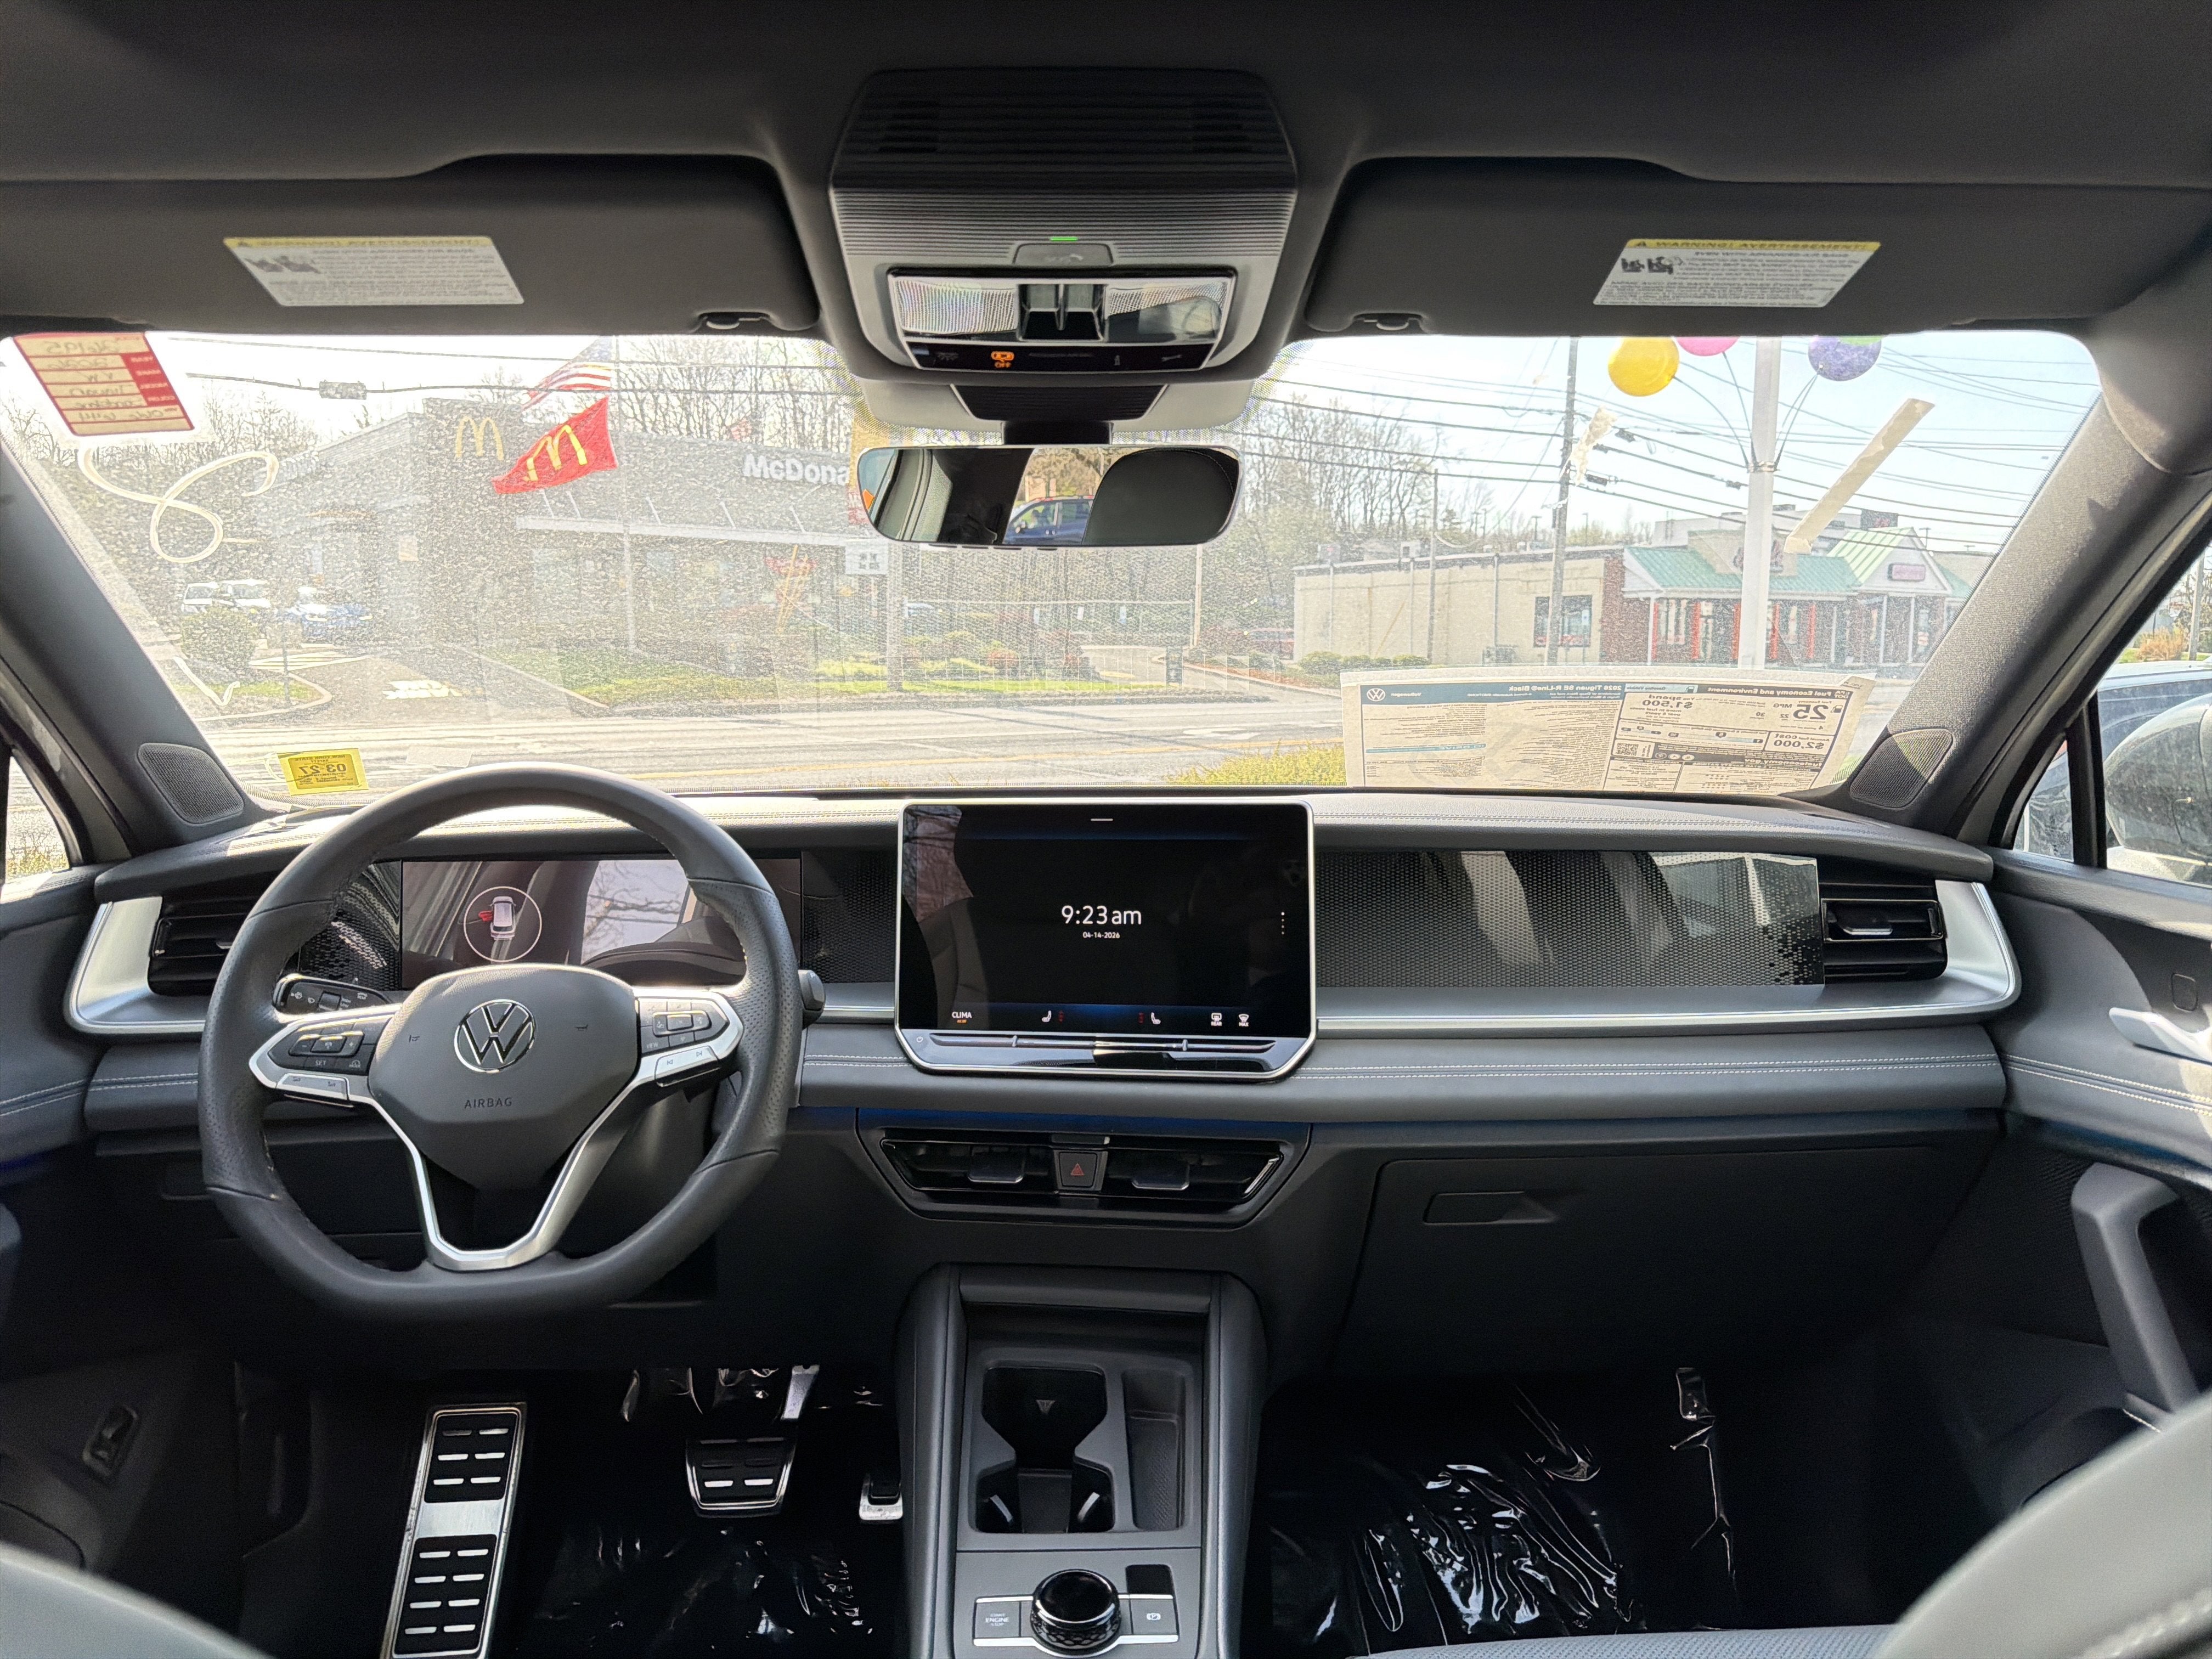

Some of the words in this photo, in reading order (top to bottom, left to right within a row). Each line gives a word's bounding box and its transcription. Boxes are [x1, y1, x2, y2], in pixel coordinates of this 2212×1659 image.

[1061, 905, 1108, 925] 9:23
[1111, 910, 1142, 926] am
[464, 1098, 513, 1109] AIRBAG
